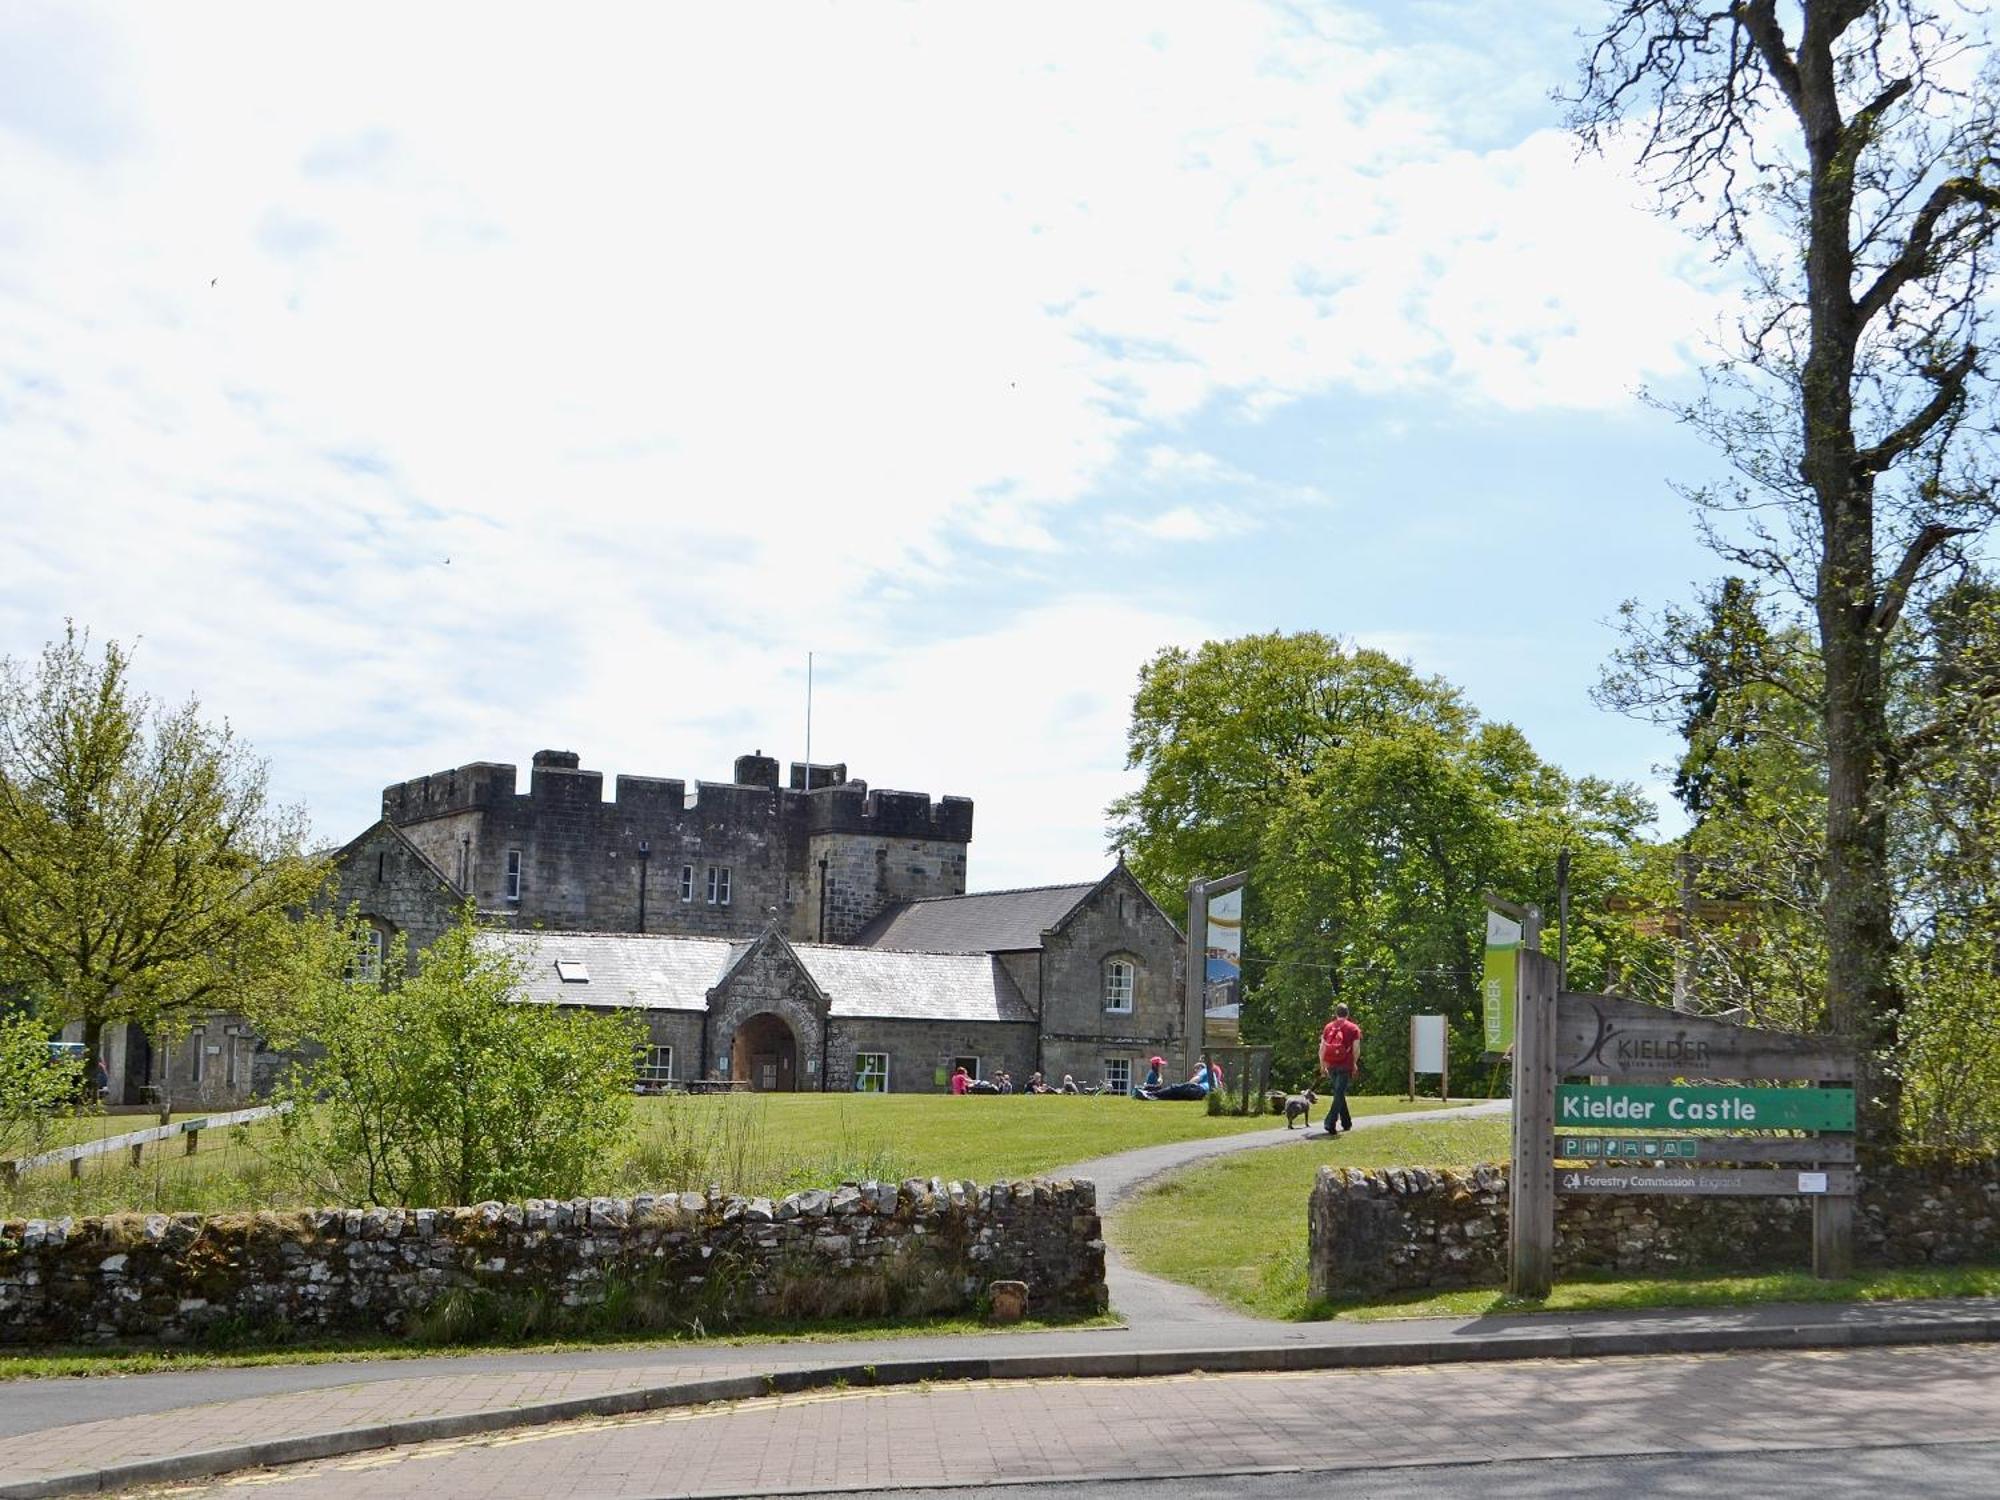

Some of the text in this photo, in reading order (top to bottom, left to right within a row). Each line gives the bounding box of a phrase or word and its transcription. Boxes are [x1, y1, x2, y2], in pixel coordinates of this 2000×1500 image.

[1487, 979, 1501, 1044] KIELDER
[1618, 1040, 1710, 1060] KIELDER
[1563, 1096, 1756, 1120] Kielder Castle
[1566, 1140, 1577, 1154] P
[1583, 1175, 1741, 1189] Forestry Commission England
